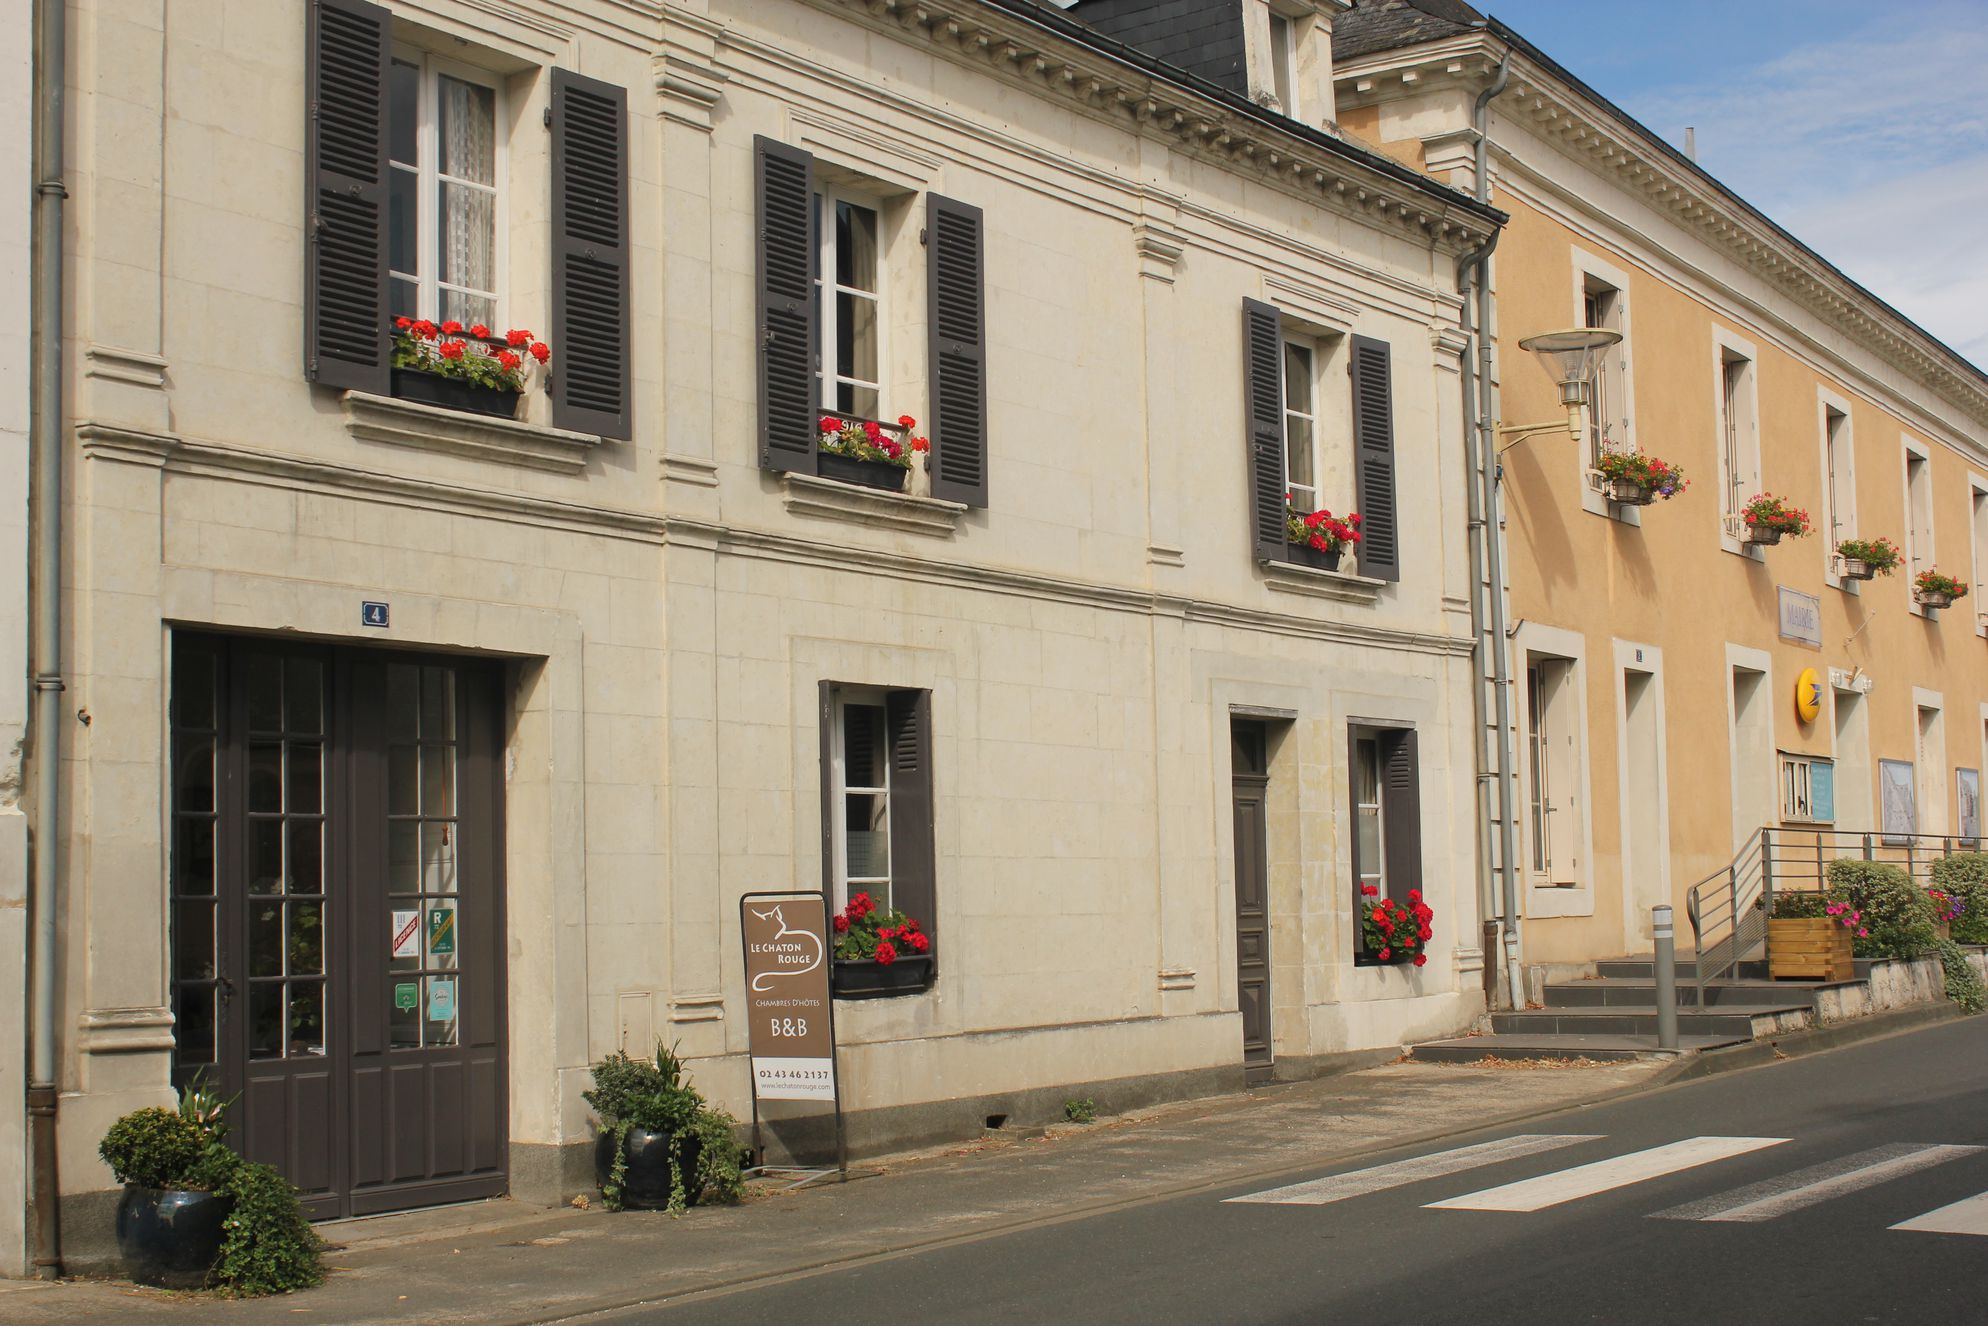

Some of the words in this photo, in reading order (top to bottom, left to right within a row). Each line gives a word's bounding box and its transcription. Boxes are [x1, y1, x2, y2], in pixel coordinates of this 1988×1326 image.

[371, 606, 381, 622] 4
[433, 912, 442, 924] R
[395, 918, 418, 947] LICENCE
[750, 943, 760, 952] LE
[762, 943, 801, 952] CHATON
[778, 954, 811, 963] ROUGE
[755, 999, 791, 1007] CHAMBRES
[792, 998, 820, 1007] D'HÔTES
[771, 1018, 808, 1037] B&B
[760, 1070, 772, 1078] 02
[775, 1070, 787, 1079] 43
[789, 1071, 801, 1079] 46
[761, 1082, 831, 1091] www.lechatonrouge.com
